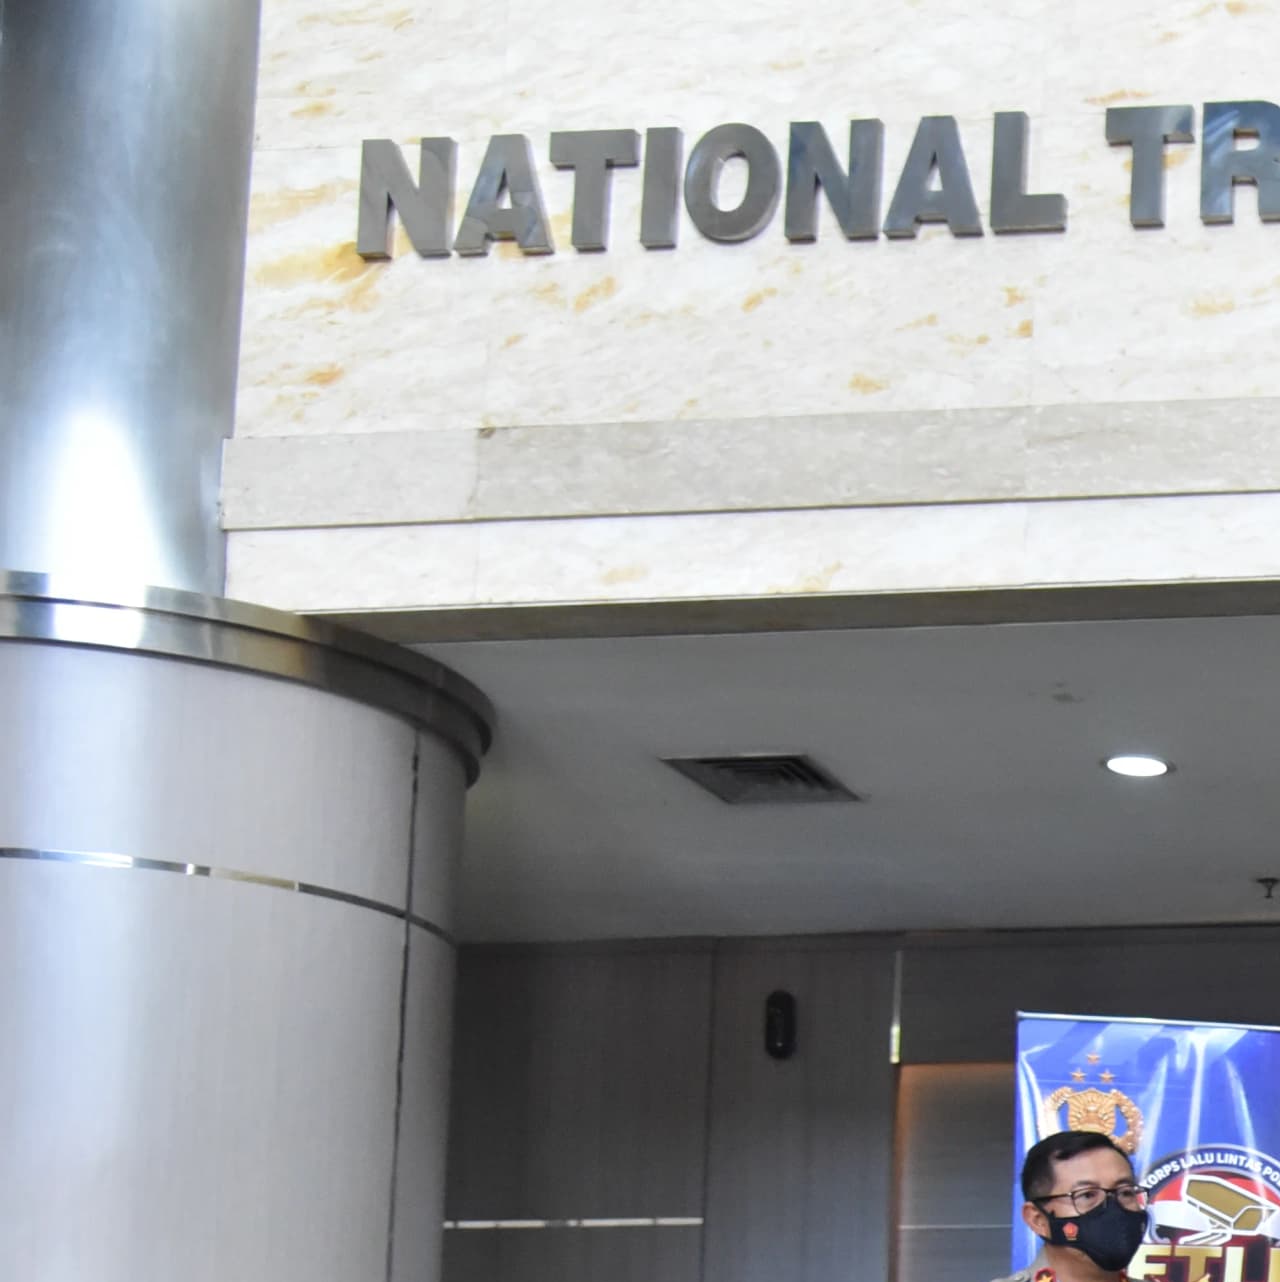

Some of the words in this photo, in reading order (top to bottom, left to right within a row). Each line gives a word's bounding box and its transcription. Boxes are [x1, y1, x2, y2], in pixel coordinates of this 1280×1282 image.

[356, 111, 1069, 262] NATIONAL
[1180, 1152, 1214, 1169] LALU
[1216, 1152, 1263, 1173] LINTAS
